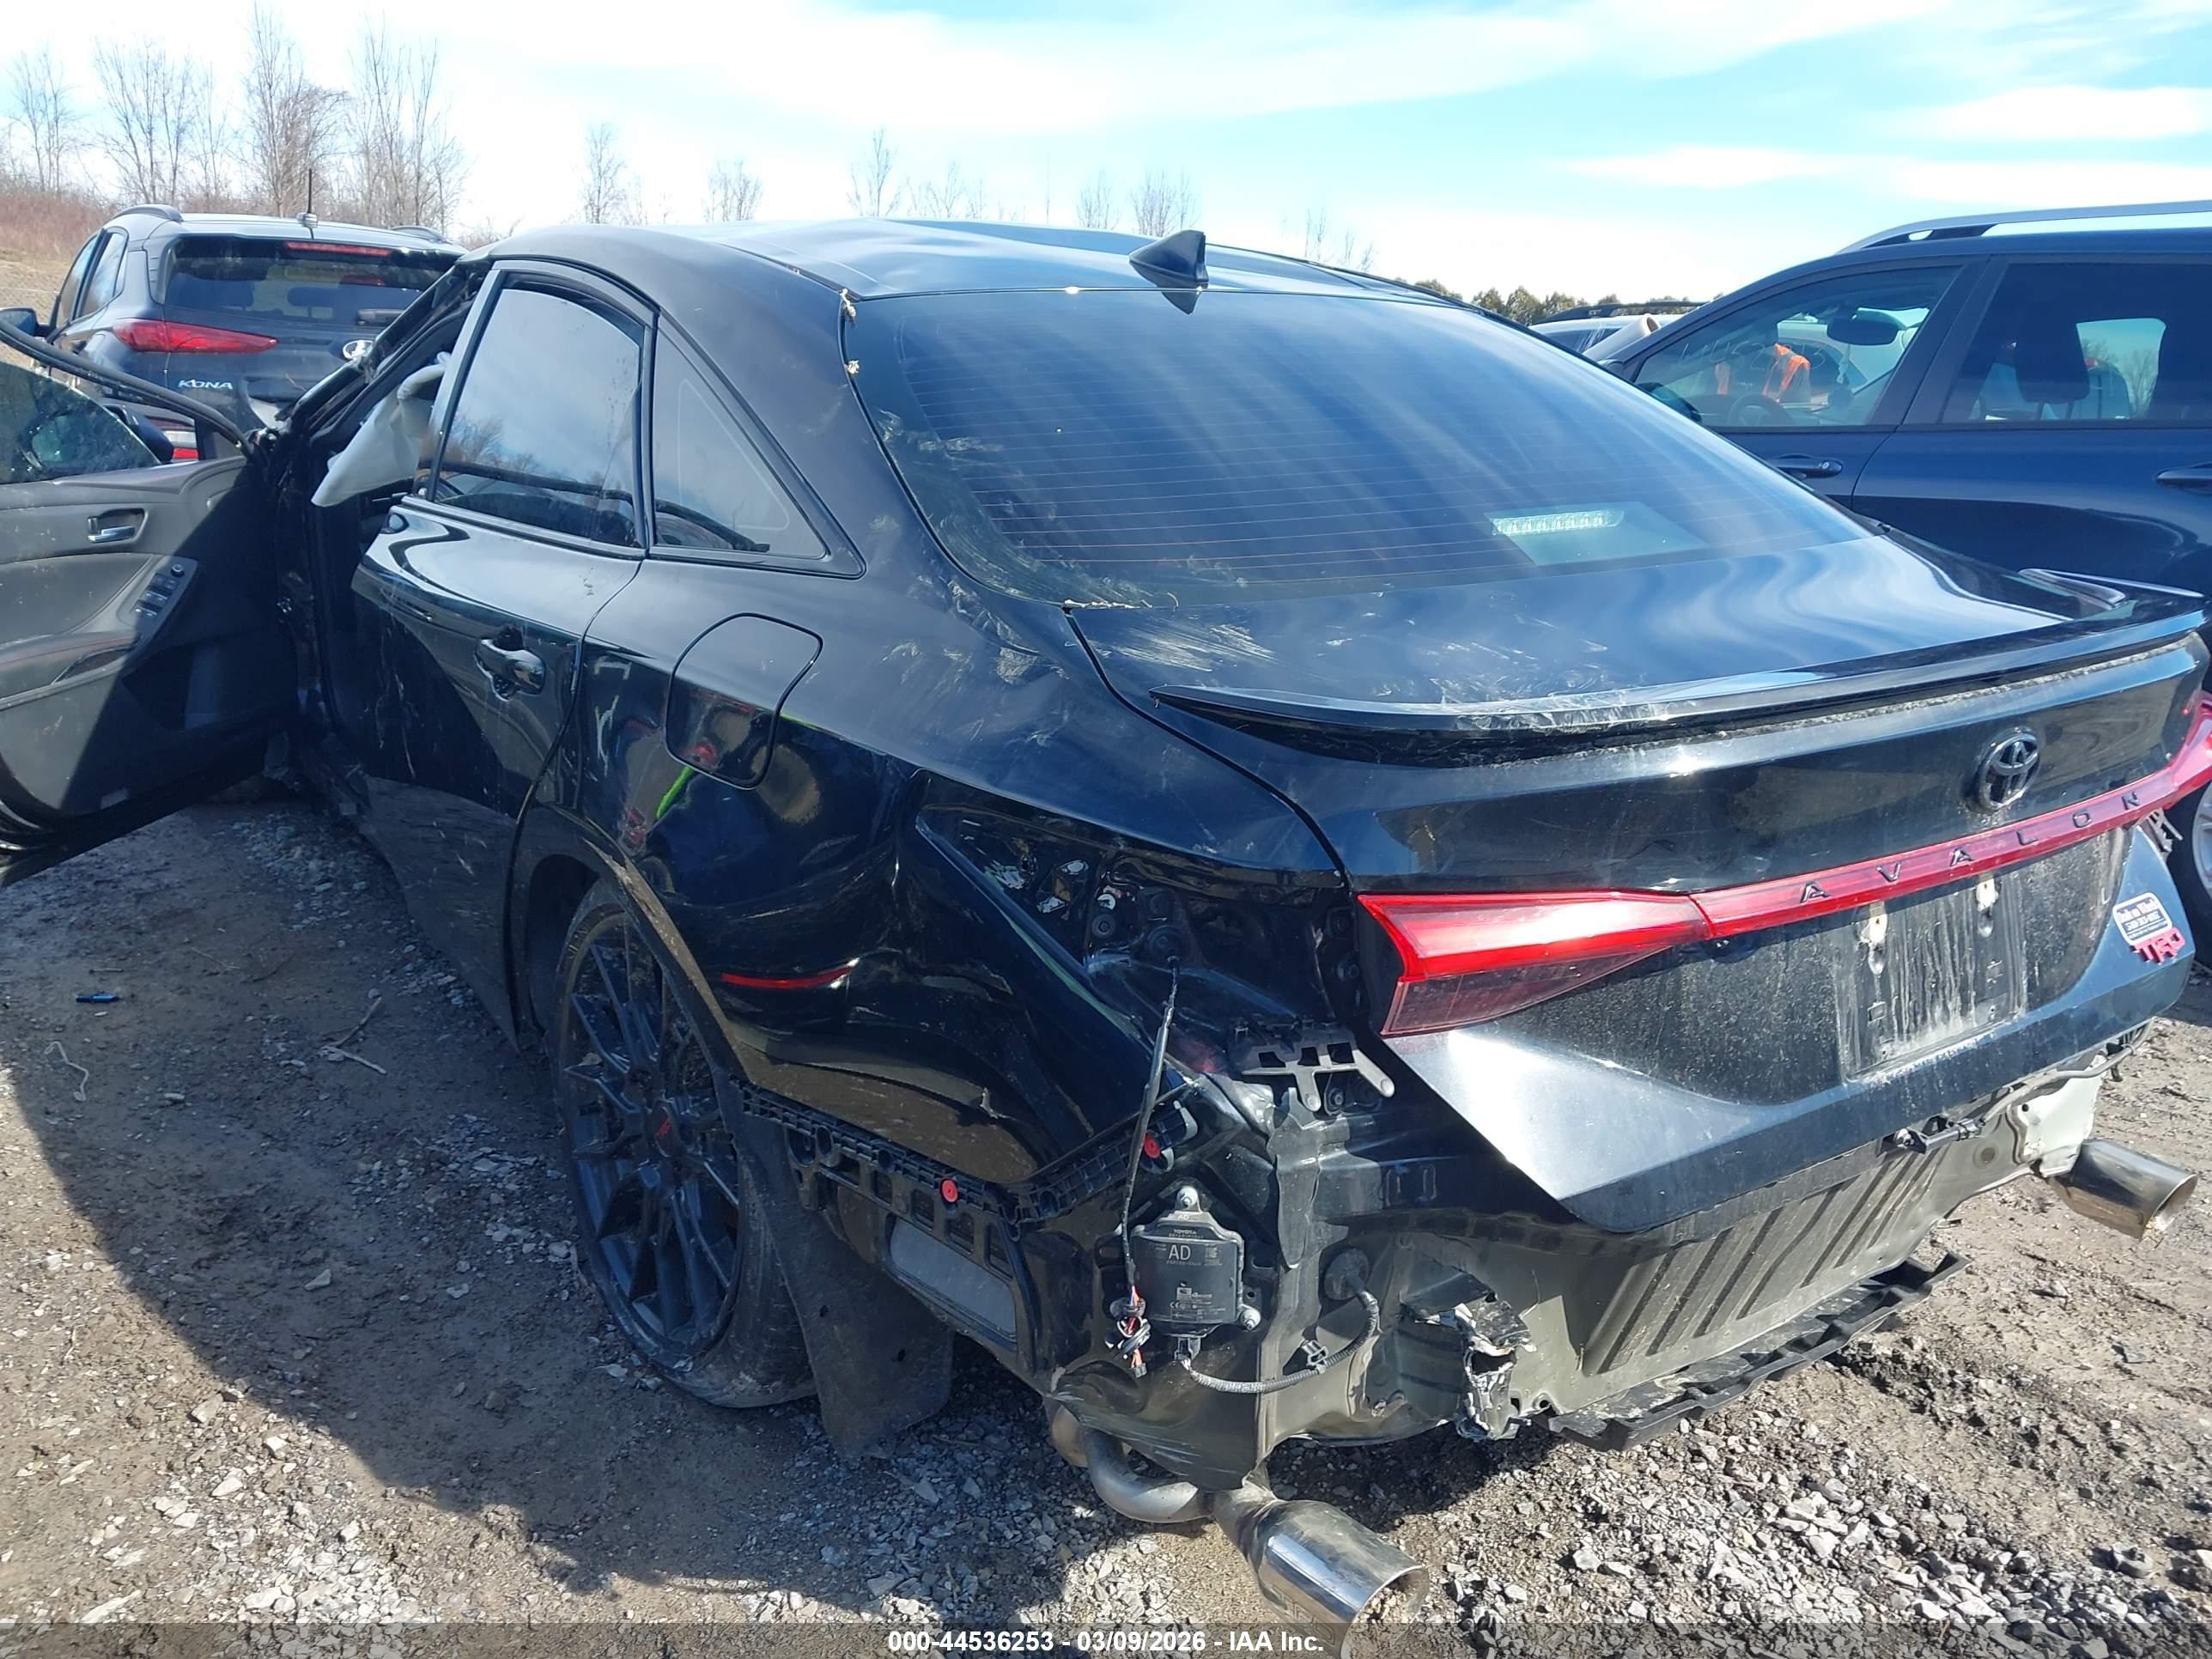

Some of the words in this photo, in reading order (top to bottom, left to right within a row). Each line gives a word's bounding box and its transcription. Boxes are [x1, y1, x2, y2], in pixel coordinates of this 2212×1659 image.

[178, 379, 234, 389] KONA
[1800, 790, 2142, 903] AVALON
[1168, 1244, 1192, 1261] AD
